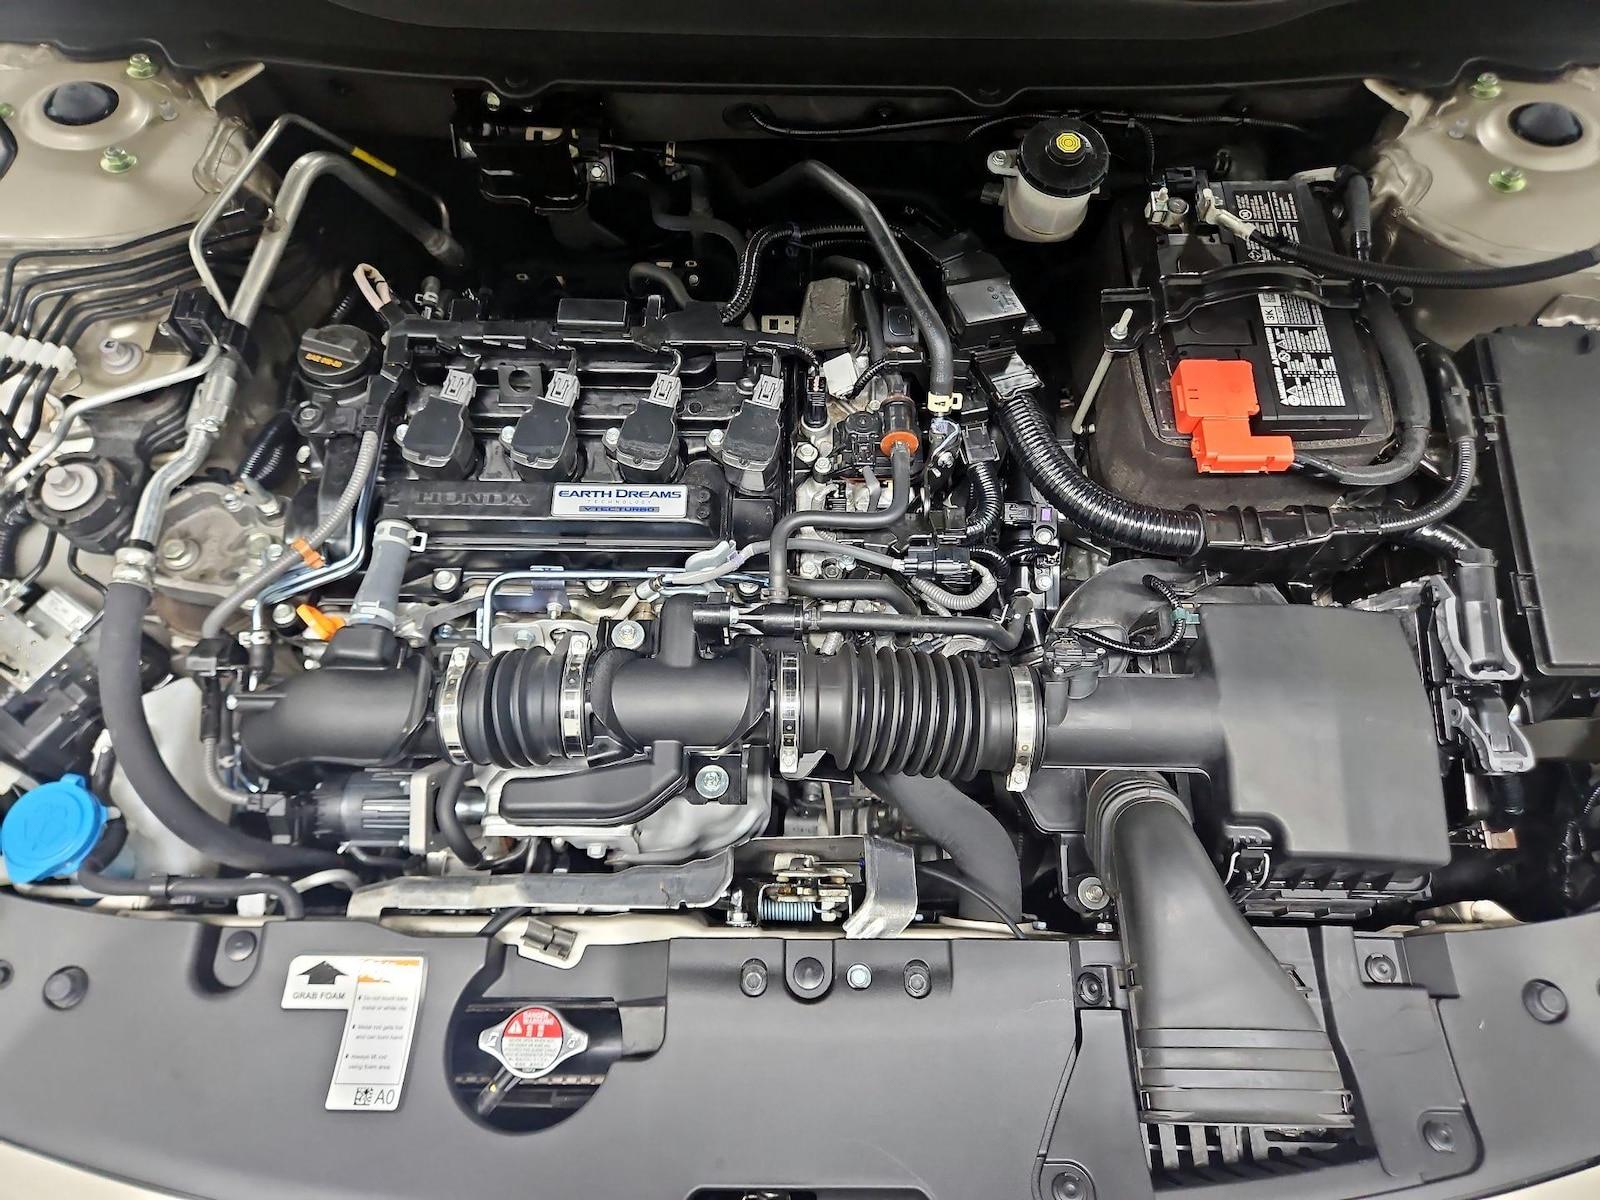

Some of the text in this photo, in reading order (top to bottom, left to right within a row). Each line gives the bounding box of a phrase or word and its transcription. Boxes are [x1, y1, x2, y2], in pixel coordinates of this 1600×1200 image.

[415, 492, 531, 506] HONDA
[559, 489, 682, 499] EARTH DREAMS
[293, 992, 346, 1000] GRAB FOAM
[374, 1089, 395, 1105] A0
